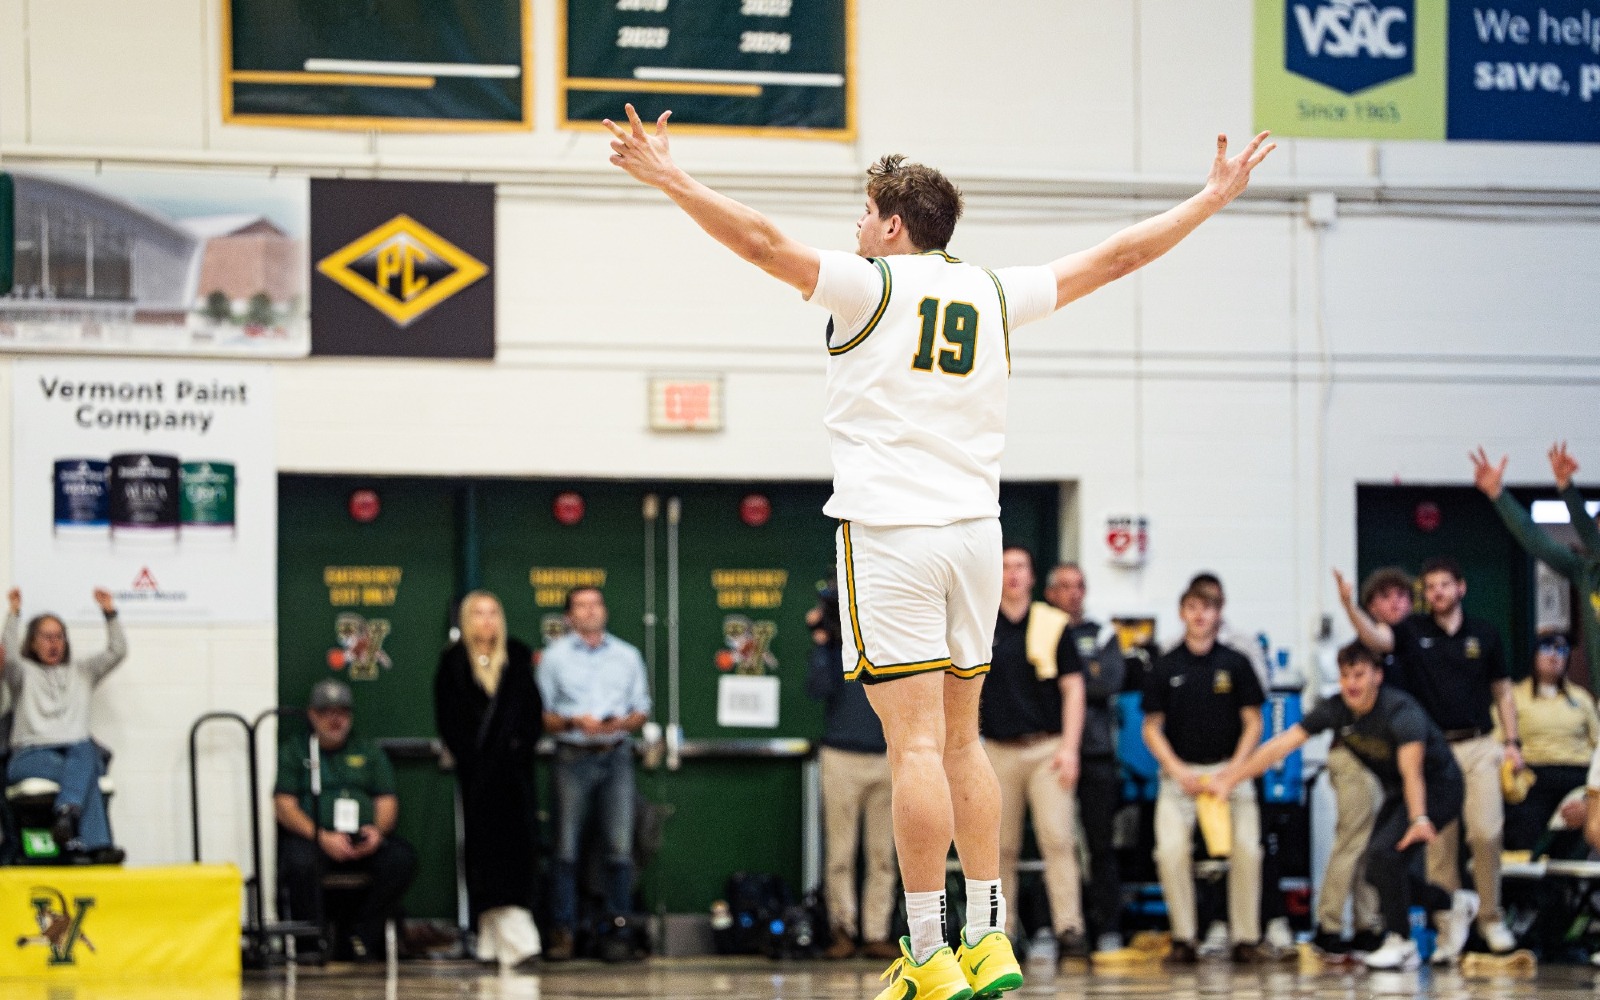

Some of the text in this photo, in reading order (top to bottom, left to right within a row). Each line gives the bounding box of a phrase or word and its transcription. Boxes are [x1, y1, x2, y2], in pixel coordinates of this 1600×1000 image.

[1293, 5, 1407, 59] VSAC
[1474, 8, 1531, 44] We
[1474, 62, 1570, 96] save,
[377, 243, 428, 298] PC
[911, 296, 979, 378] 19
[40, 377, 248, 404] Vermont Paint
[75, 406, 214, 434] Company
